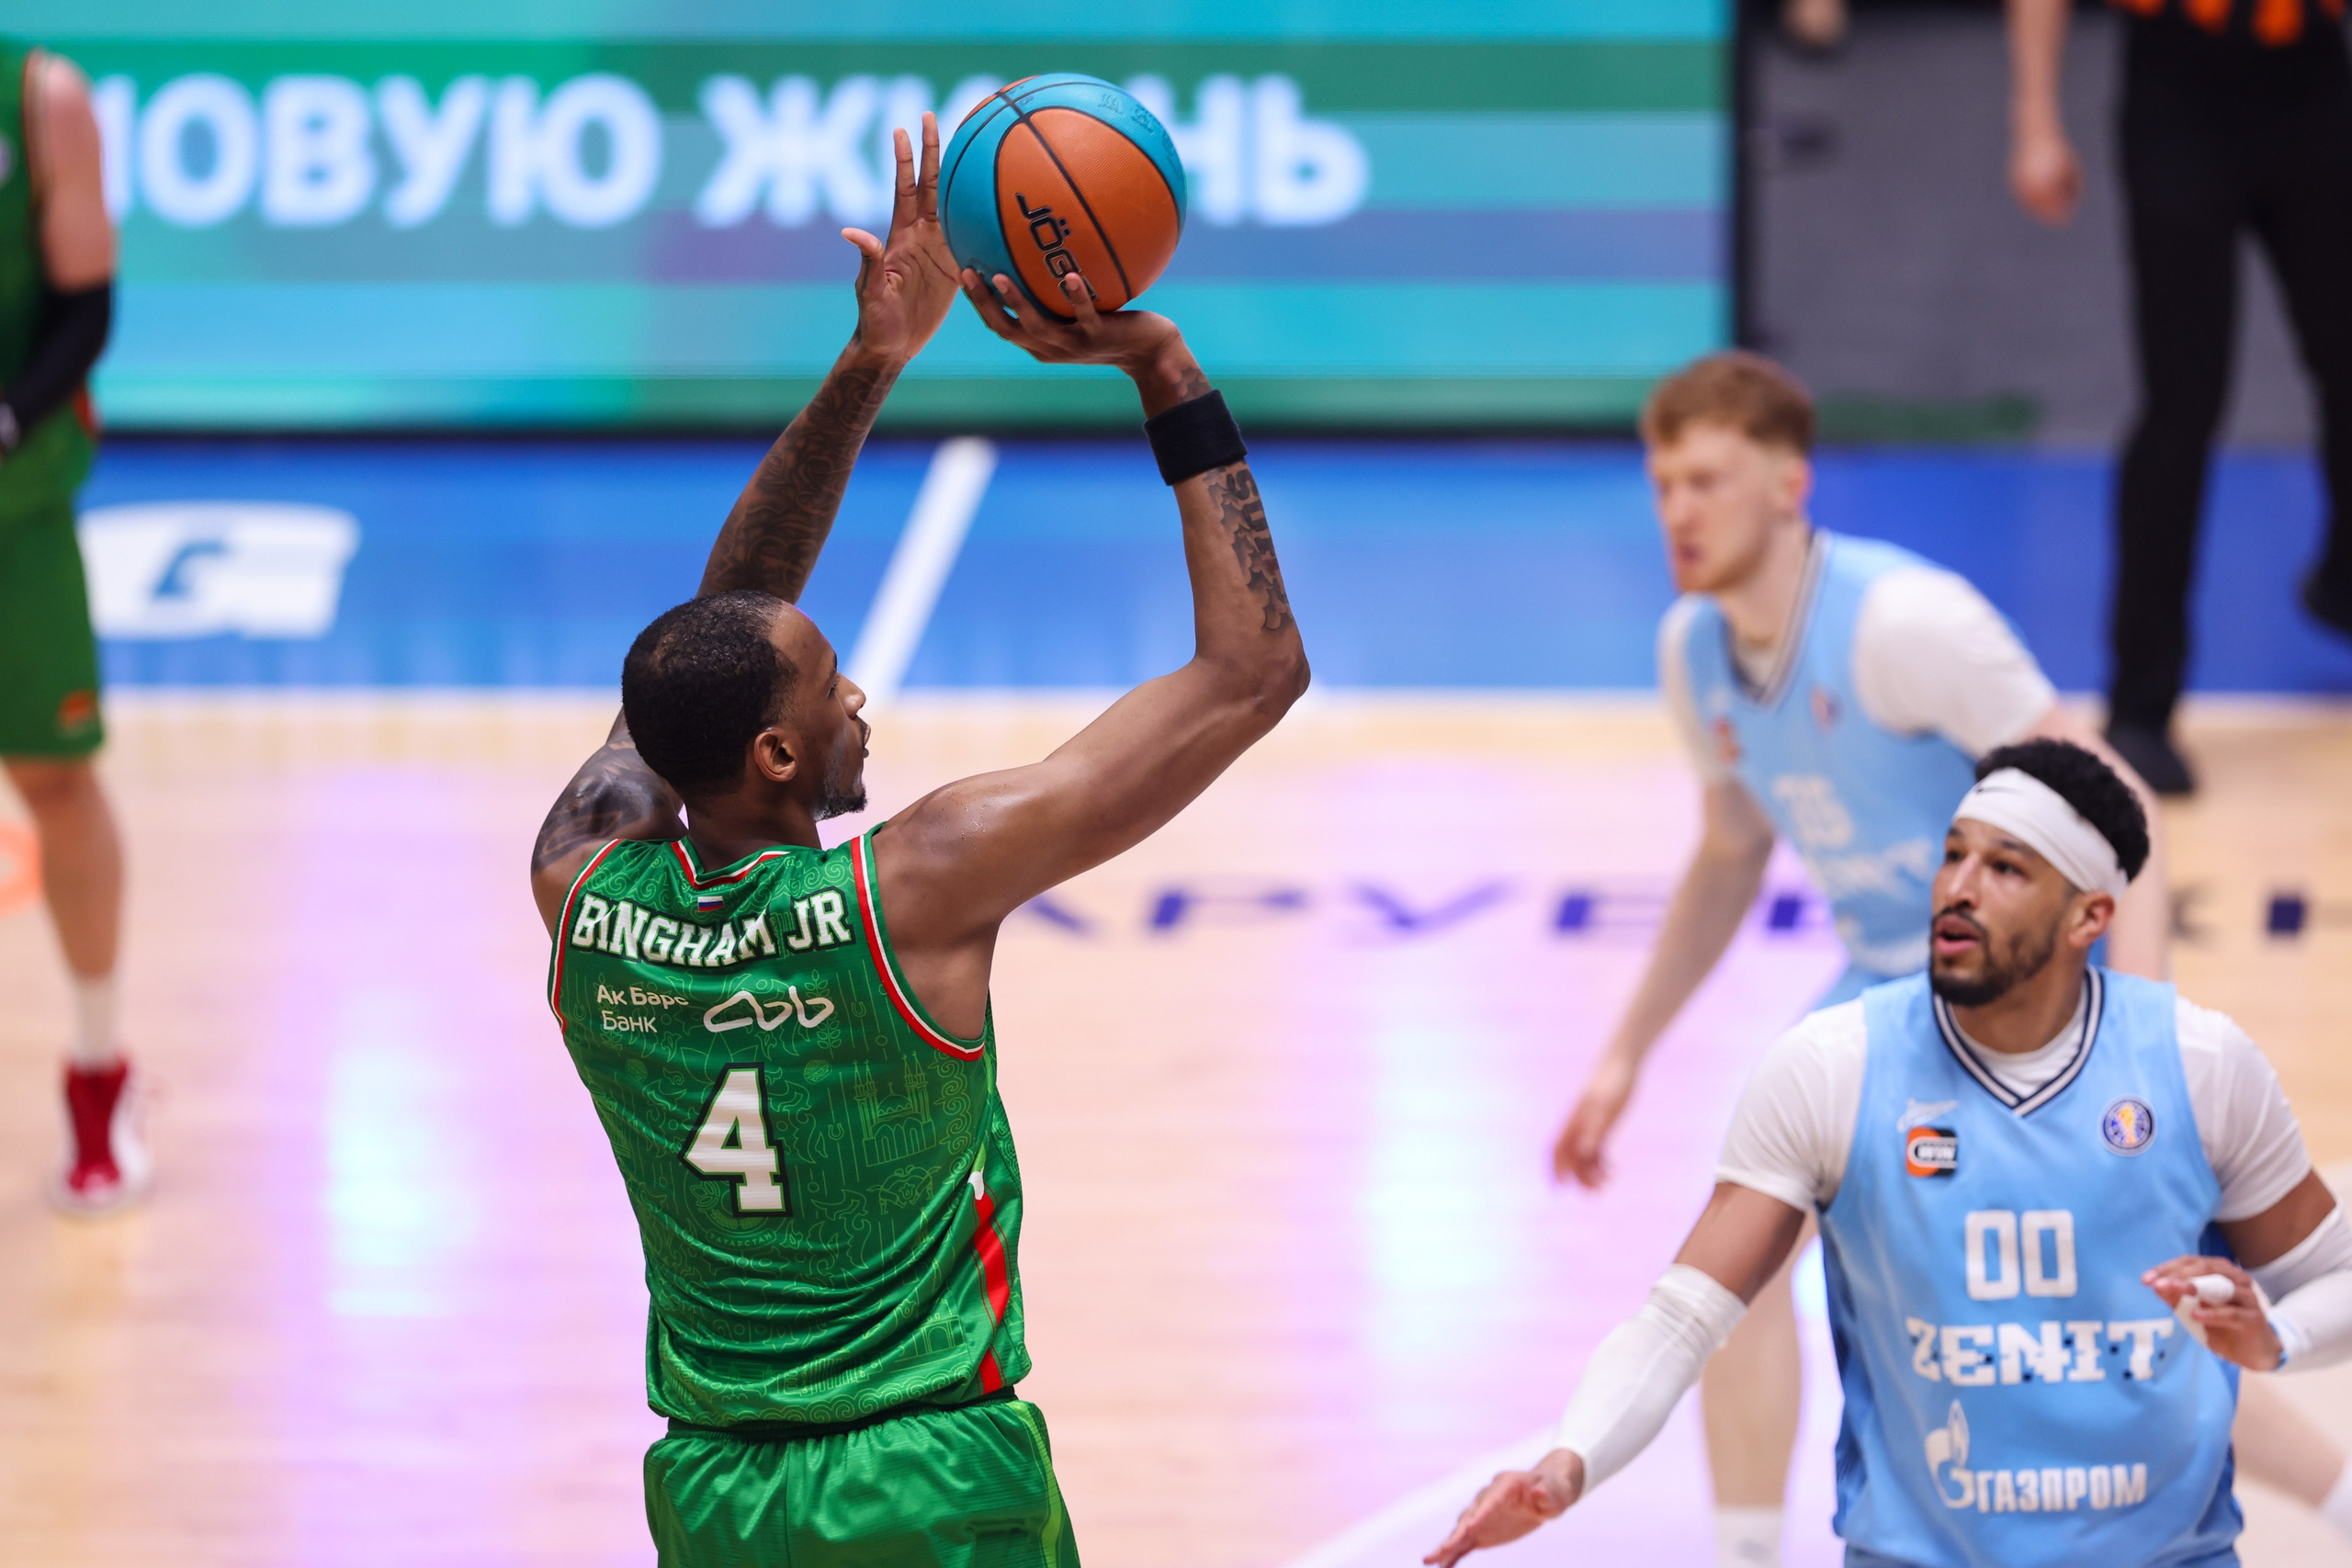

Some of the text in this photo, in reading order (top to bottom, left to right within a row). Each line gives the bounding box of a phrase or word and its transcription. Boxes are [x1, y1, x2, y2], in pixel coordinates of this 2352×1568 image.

[571, 889, 854, 968] BINGHAM JR
[597, 984, 628, 1007] Ак
[629, 986, 689, 1010] Барс
[603, 1010, 658, 1033] Банк
[684, 1066, 787, 1213] 4
[1964, 1209, 2078, 1301] 00
[1905, 1316, 2176, 1387] ZENIT
[1976, 1462, 2148, 1514] ГАЗПРОМ
